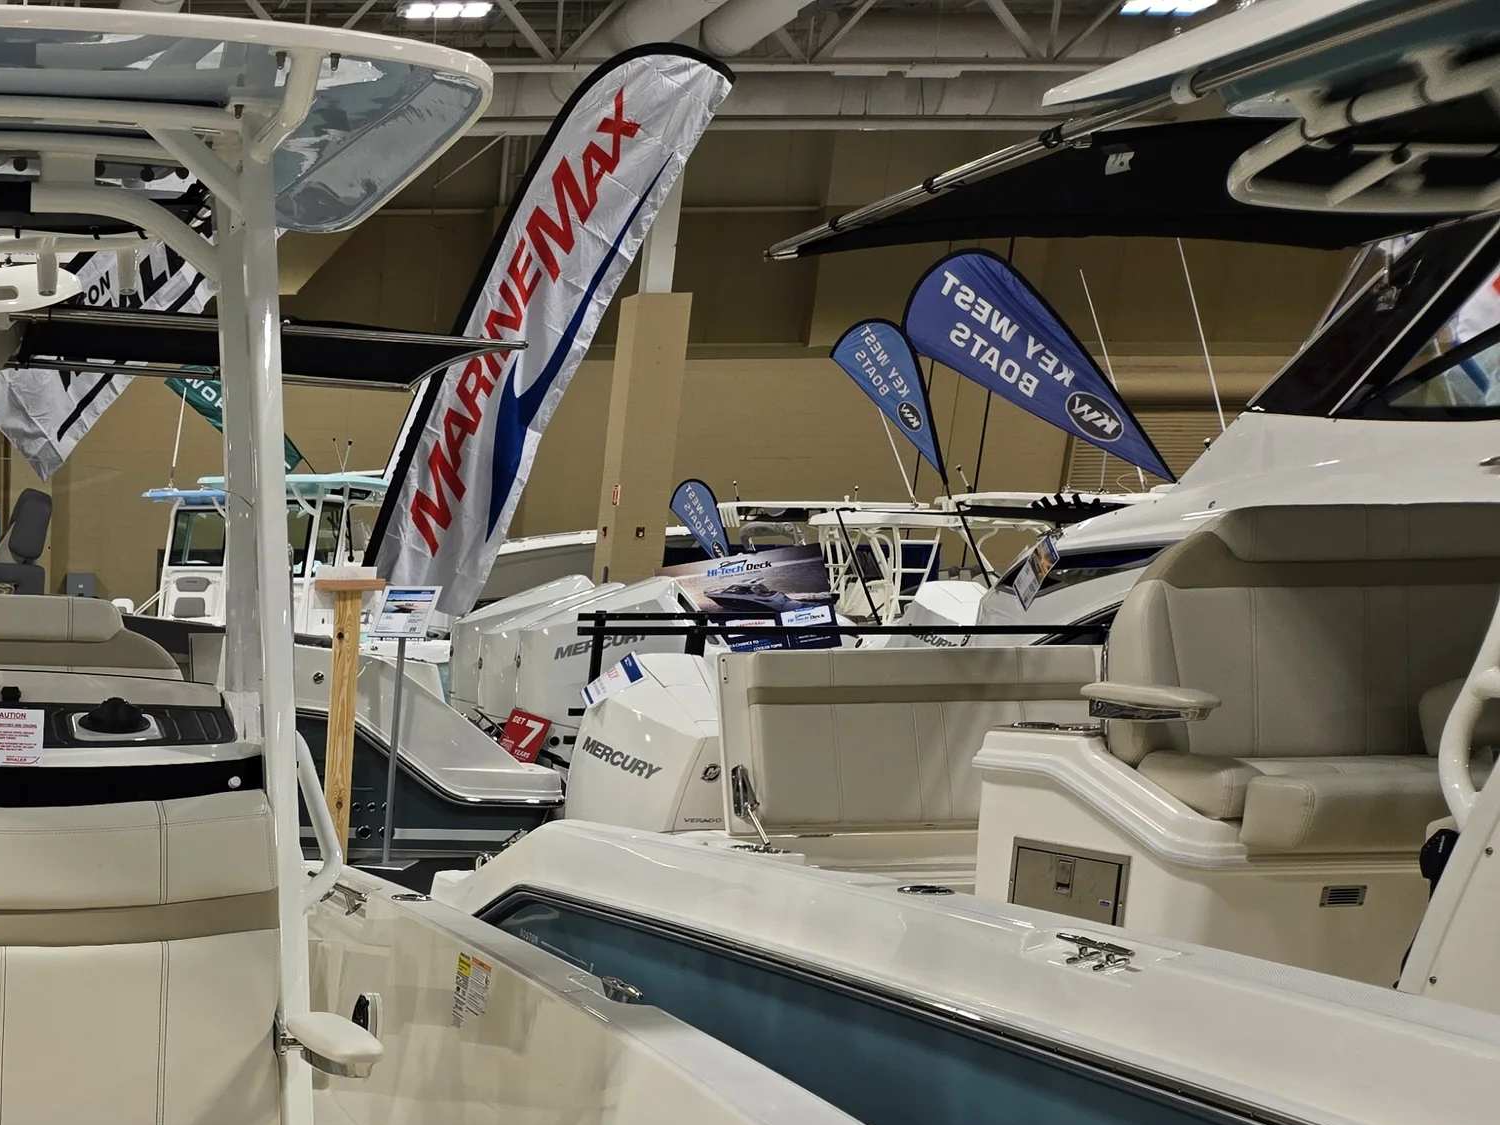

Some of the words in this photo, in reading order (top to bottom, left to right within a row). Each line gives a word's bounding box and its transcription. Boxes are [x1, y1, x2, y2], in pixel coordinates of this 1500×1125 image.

[746, 561, 772, 571] Deck
[512, 715, 527, 725] GET
[518, 719, 545, 749] 7
[513, 749, 531, 759] YEARS
[582, 736, 663, 780] MERCURY
[519, 927, 540, 945] BOSTON
